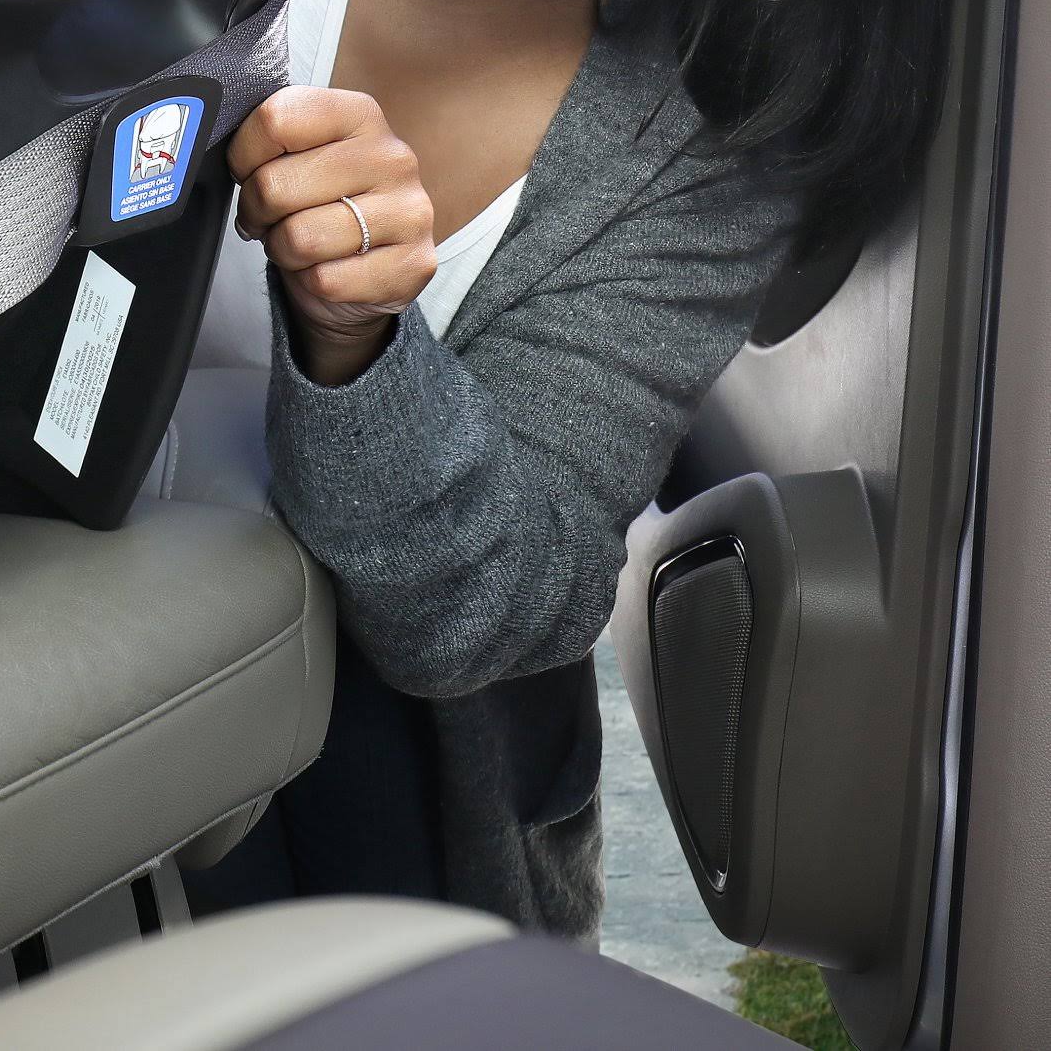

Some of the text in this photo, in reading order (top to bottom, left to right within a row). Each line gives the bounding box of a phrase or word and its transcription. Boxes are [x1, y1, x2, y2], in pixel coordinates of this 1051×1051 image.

[129, 175, 172, 194] CARRIER ONLY
[121, 183, 175, 206] ASIENTO SIN BASE
[139, 198, 156, 208] SANS
[157, 193, 172, 204] BASE
